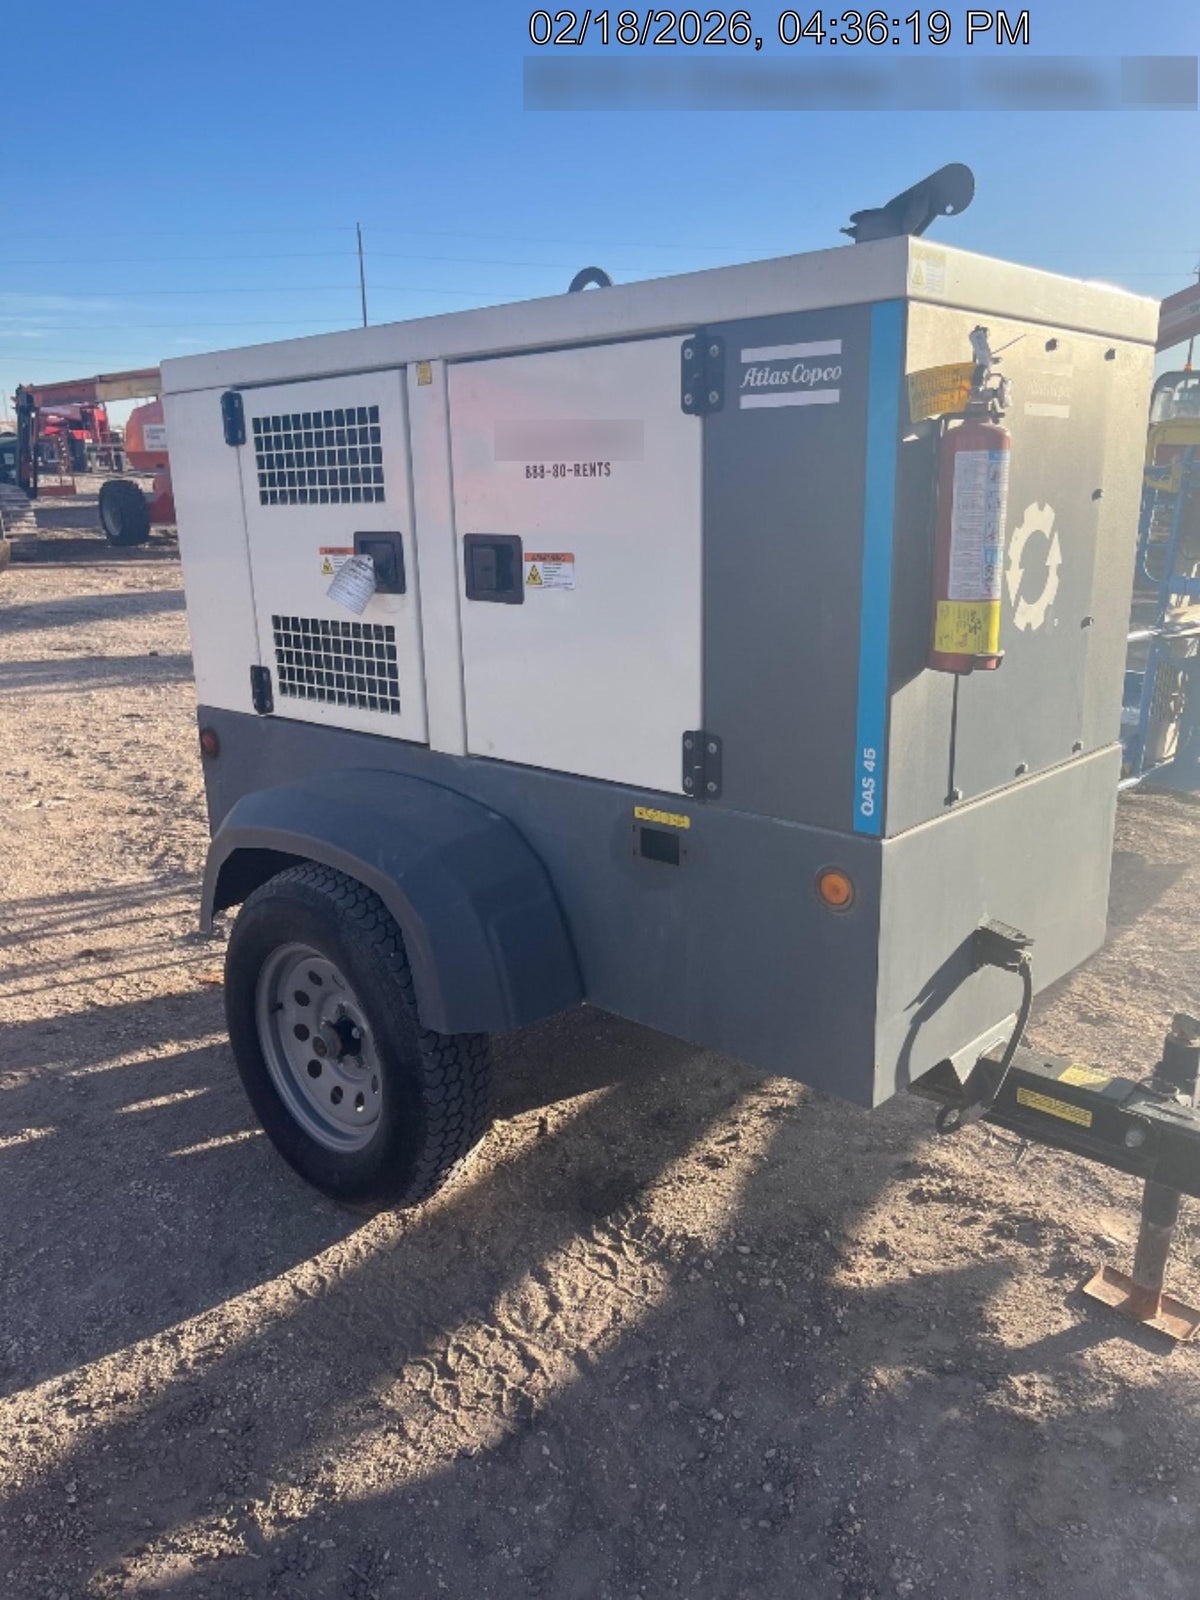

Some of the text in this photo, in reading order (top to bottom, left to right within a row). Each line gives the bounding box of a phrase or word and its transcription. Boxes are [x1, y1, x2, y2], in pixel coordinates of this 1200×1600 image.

[740, 363, 842, 388] Atlas Copco
[860, 748, 876, 816] QAS 45
